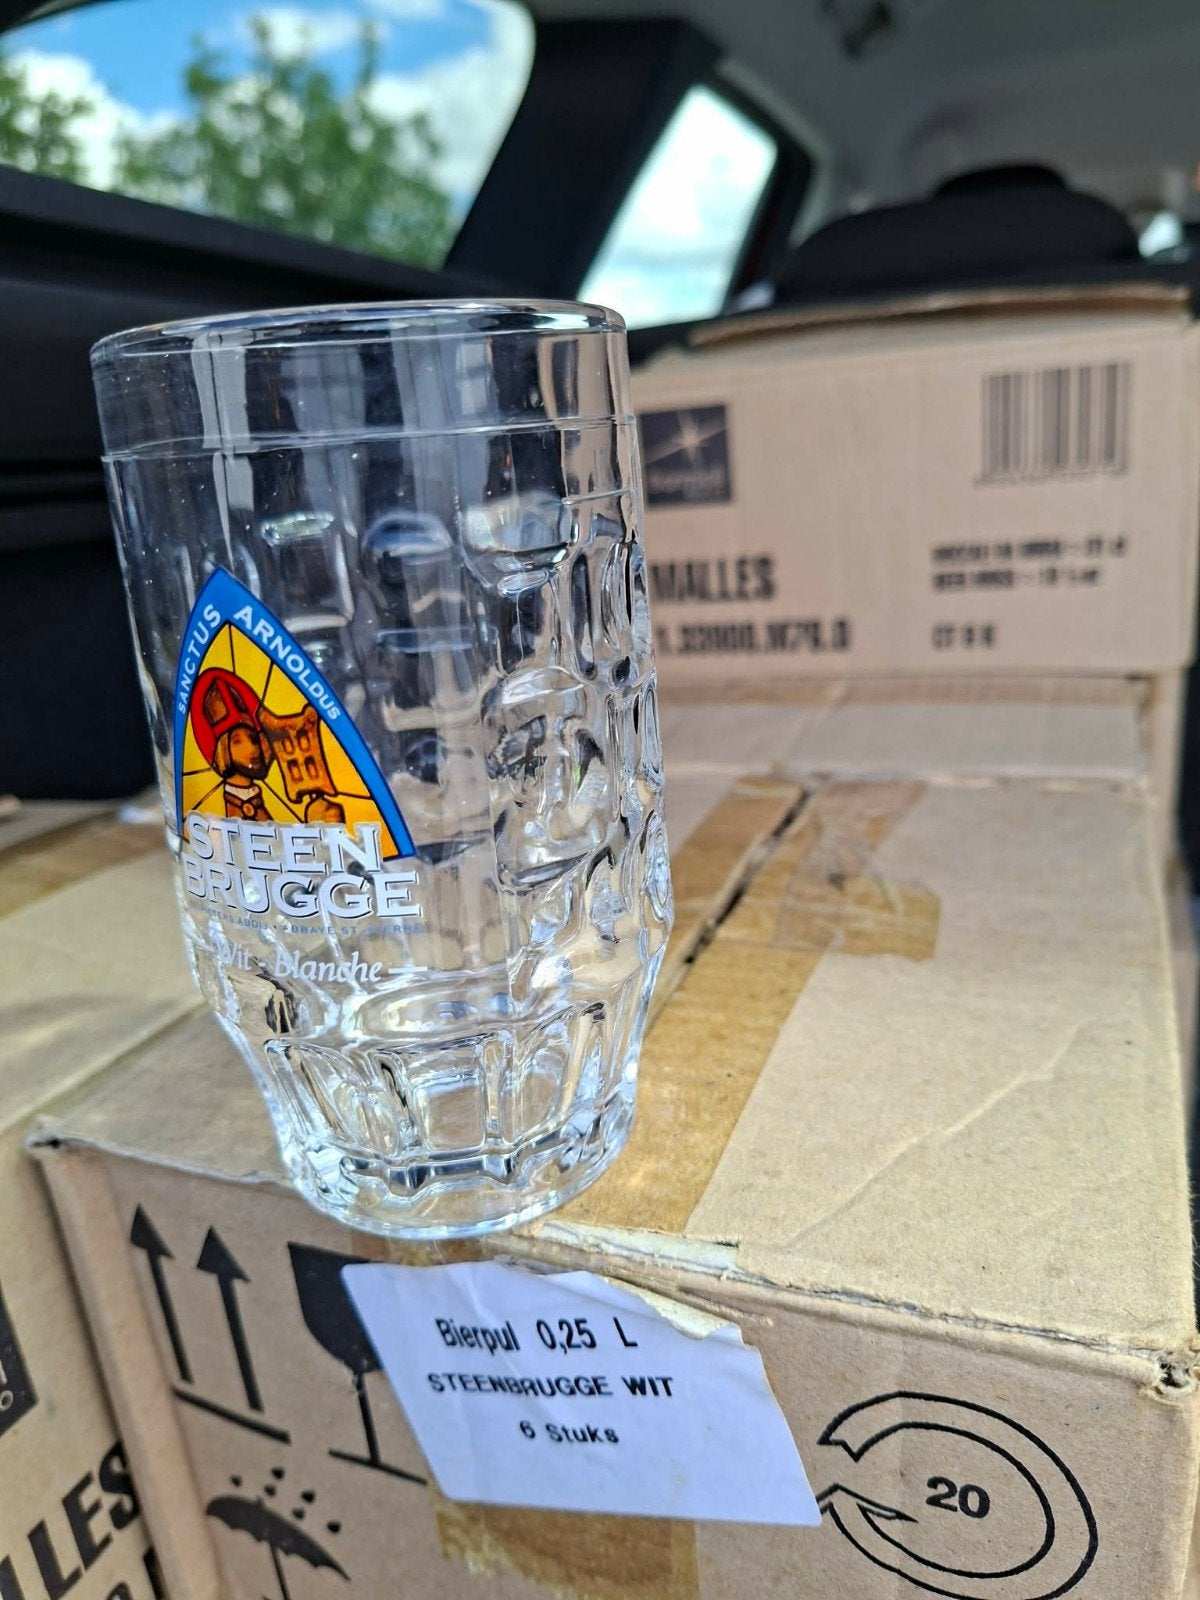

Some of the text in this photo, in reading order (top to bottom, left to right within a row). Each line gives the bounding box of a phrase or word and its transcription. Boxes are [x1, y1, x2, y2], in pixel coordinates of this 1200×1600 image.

[178, 603, 221, 714] SANCTUS
[233, 604, 341, 720] ARNOLDUS
[187, 810, 382, 874] STEEN
[182, 852, 423, 919] BRUGGE
[435, 1316, 638, 1355] Bierpul 0,25 L
[428, 1373, 673, 1397] STEENBRUGGE WIT
[519, 1420, 619, 1443] 6 Stuks
[925, 1476, 990, 1519] 20
